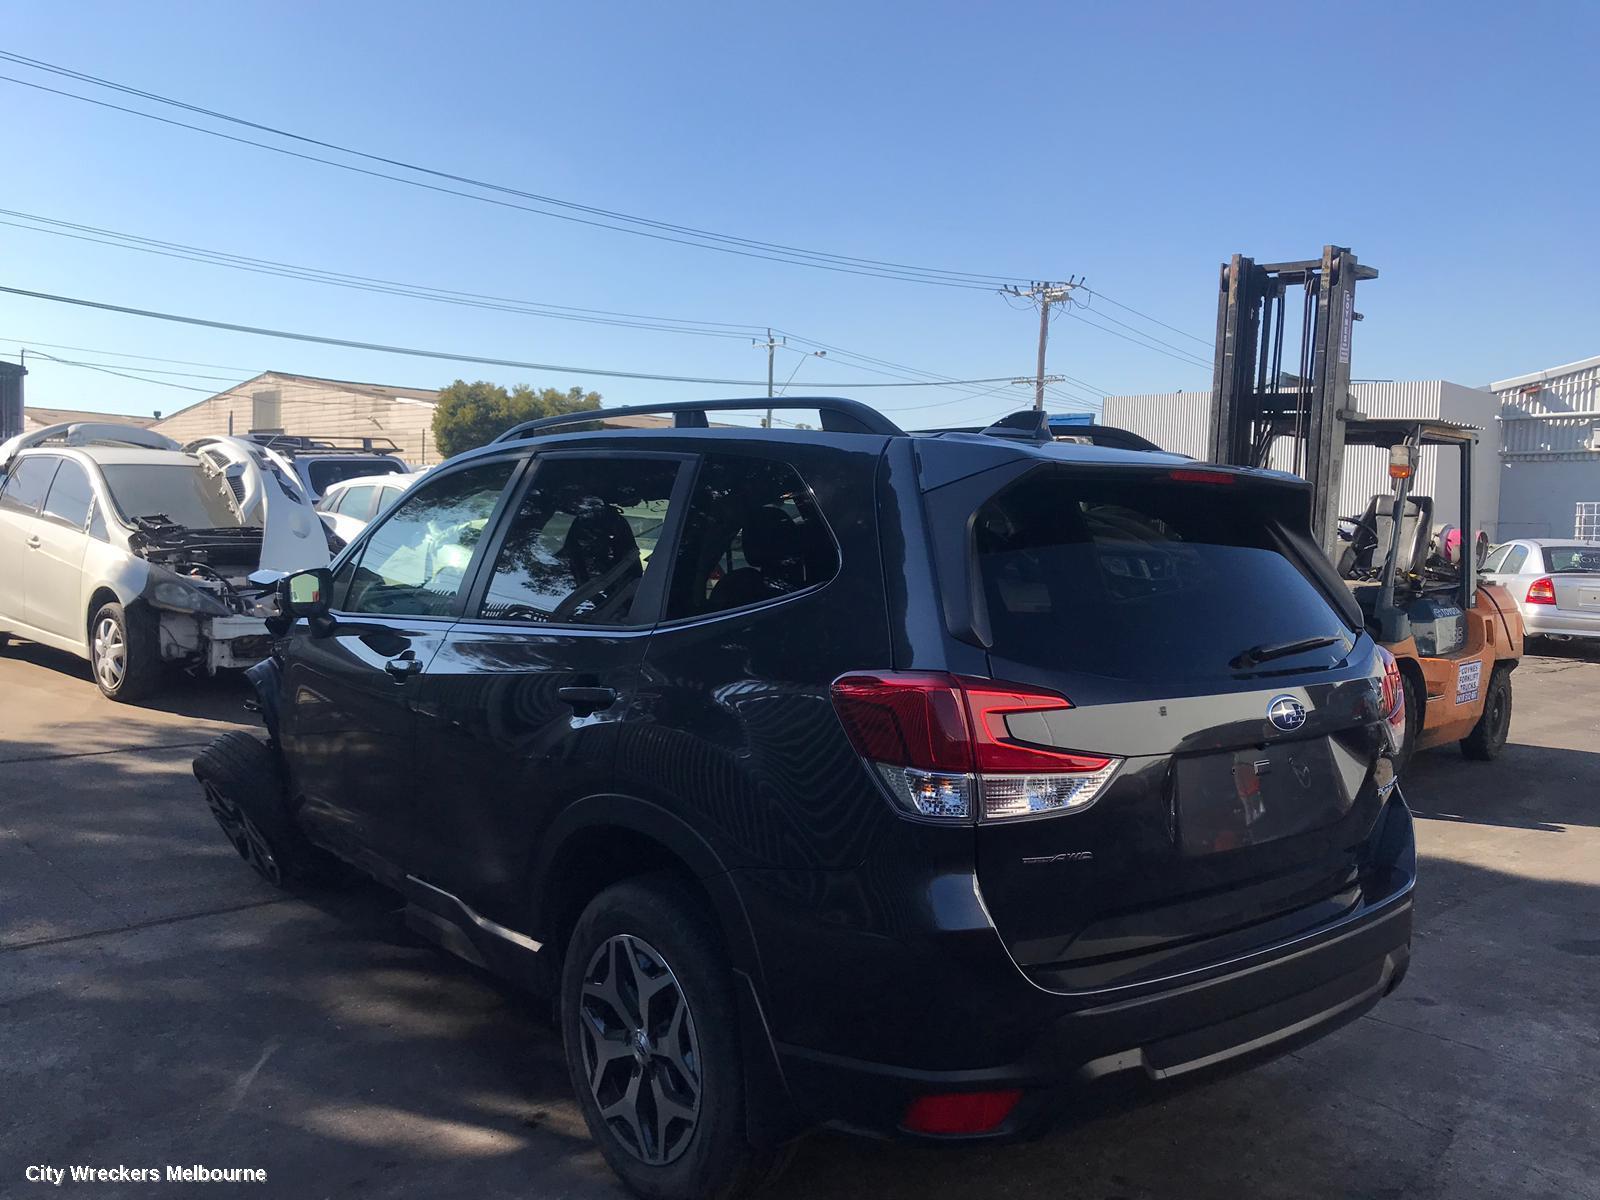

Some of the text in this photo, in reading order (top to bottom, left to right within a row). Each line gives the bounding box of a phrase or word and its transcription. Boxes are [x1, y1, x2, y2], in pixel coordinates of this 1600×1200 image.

[1440, 606, 1462, 616] TOYOTA
[1459, 672, 1479, 683] FORKLIFT
[1460, 681, 1477, 691] TRUCKS
